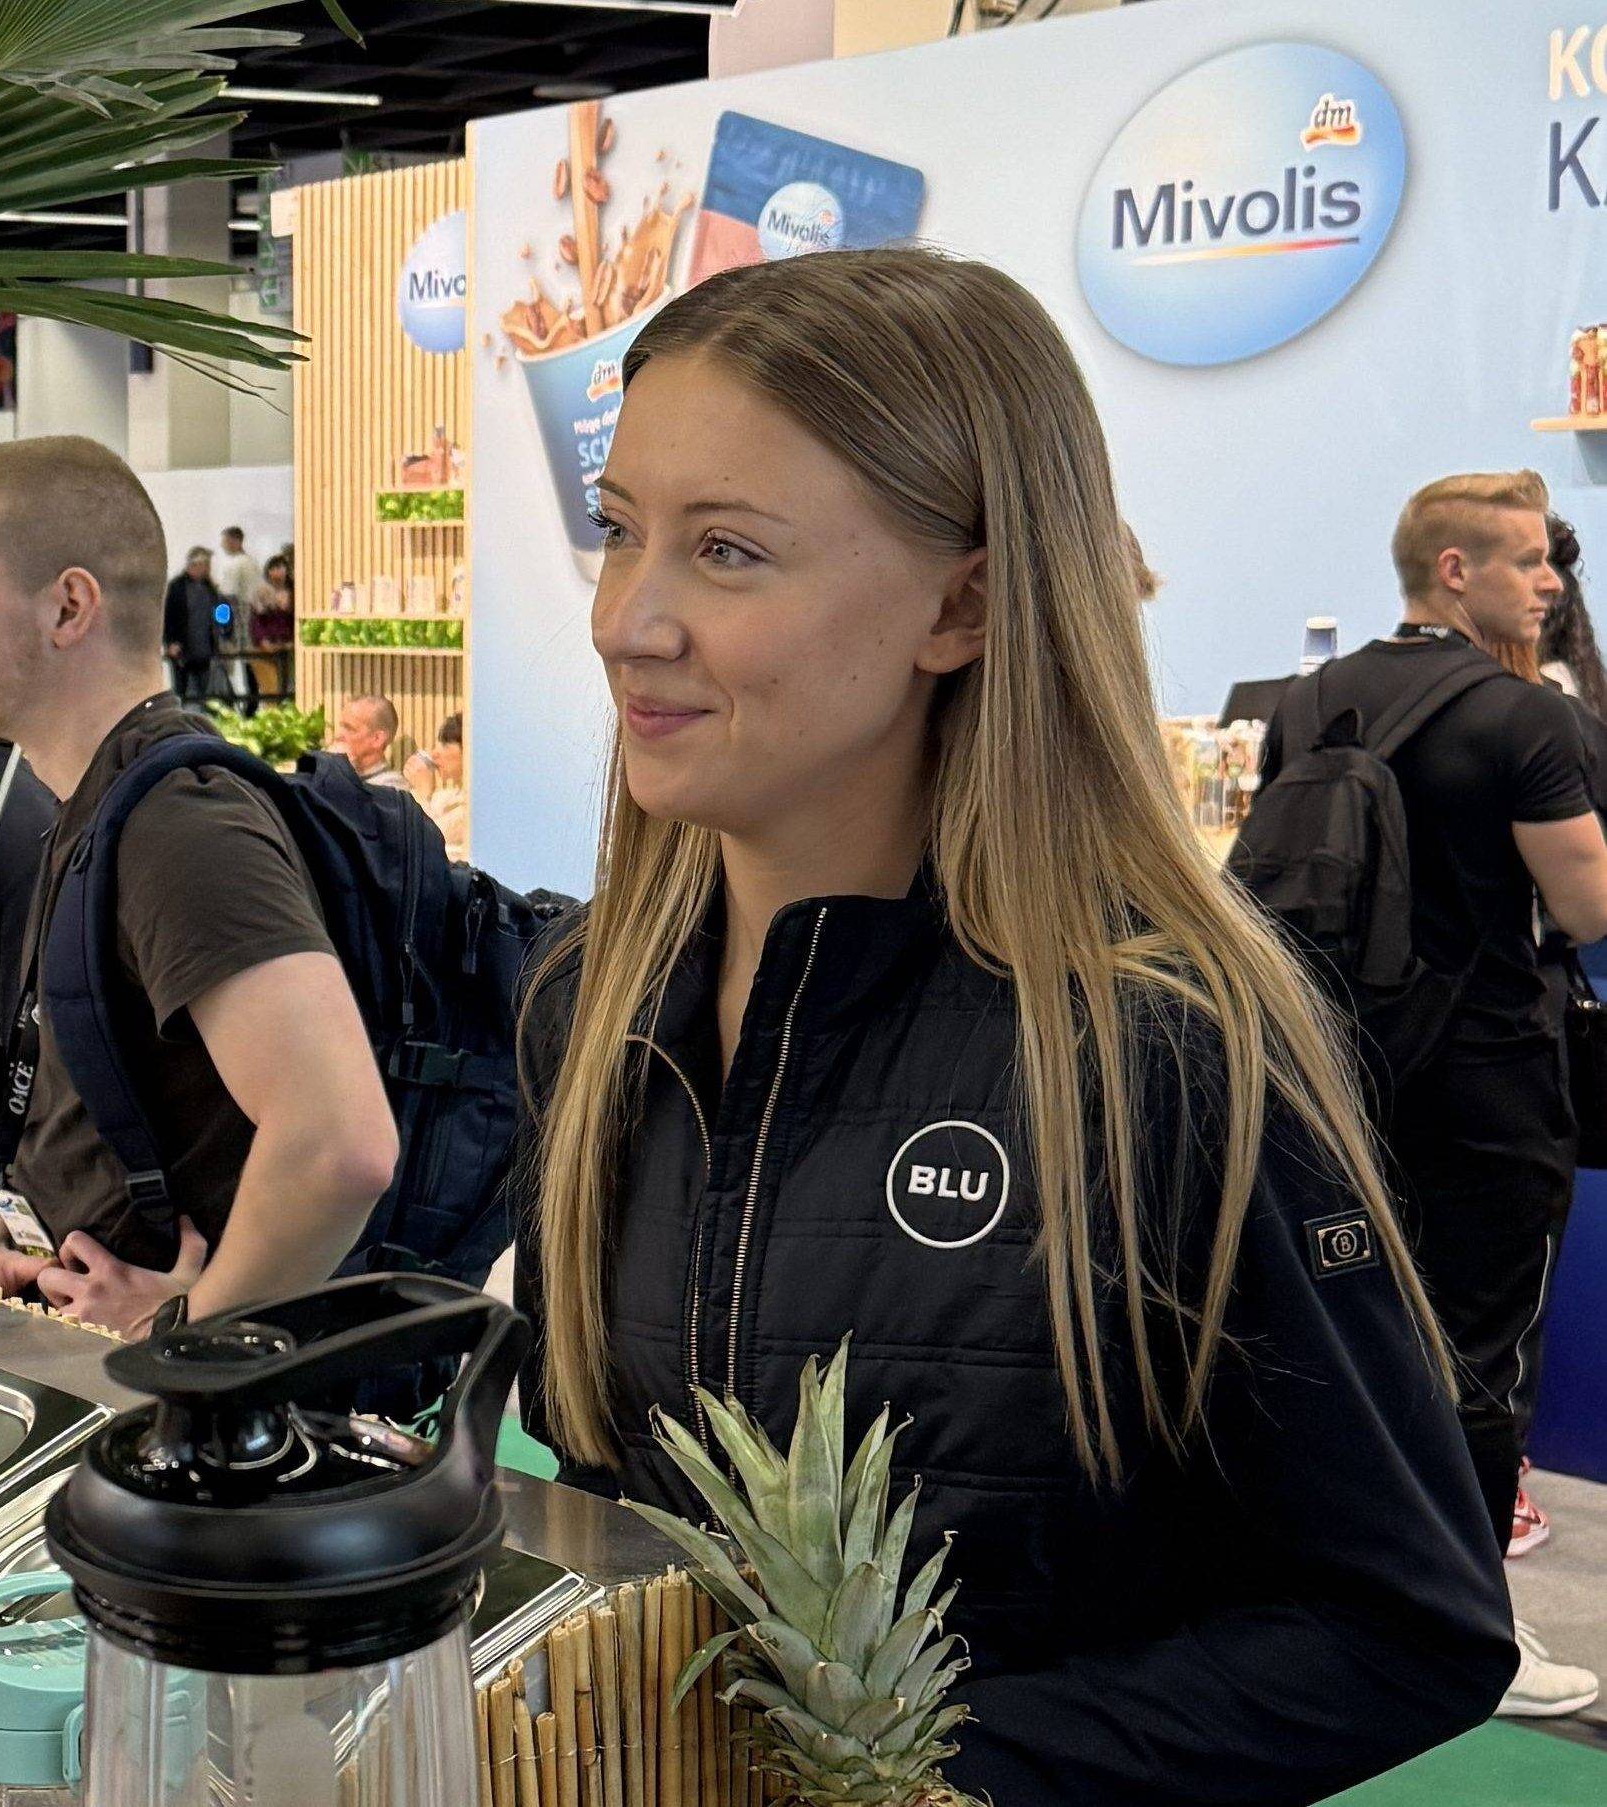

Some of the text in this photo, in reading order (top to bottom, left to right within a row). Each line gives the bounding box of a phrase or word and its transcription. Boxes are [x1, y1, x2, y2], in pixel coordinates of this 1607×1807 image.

[1313, 98, 1353, 129] dm
[1548, 116, 1607, 212] K
[1112, 164, 1362, 250] Mivolis
[767, 208, 831, 246] Mivolis
[907, 1164, 990, 1202] BLU
[1340, 1234, 1352, 1253] B
